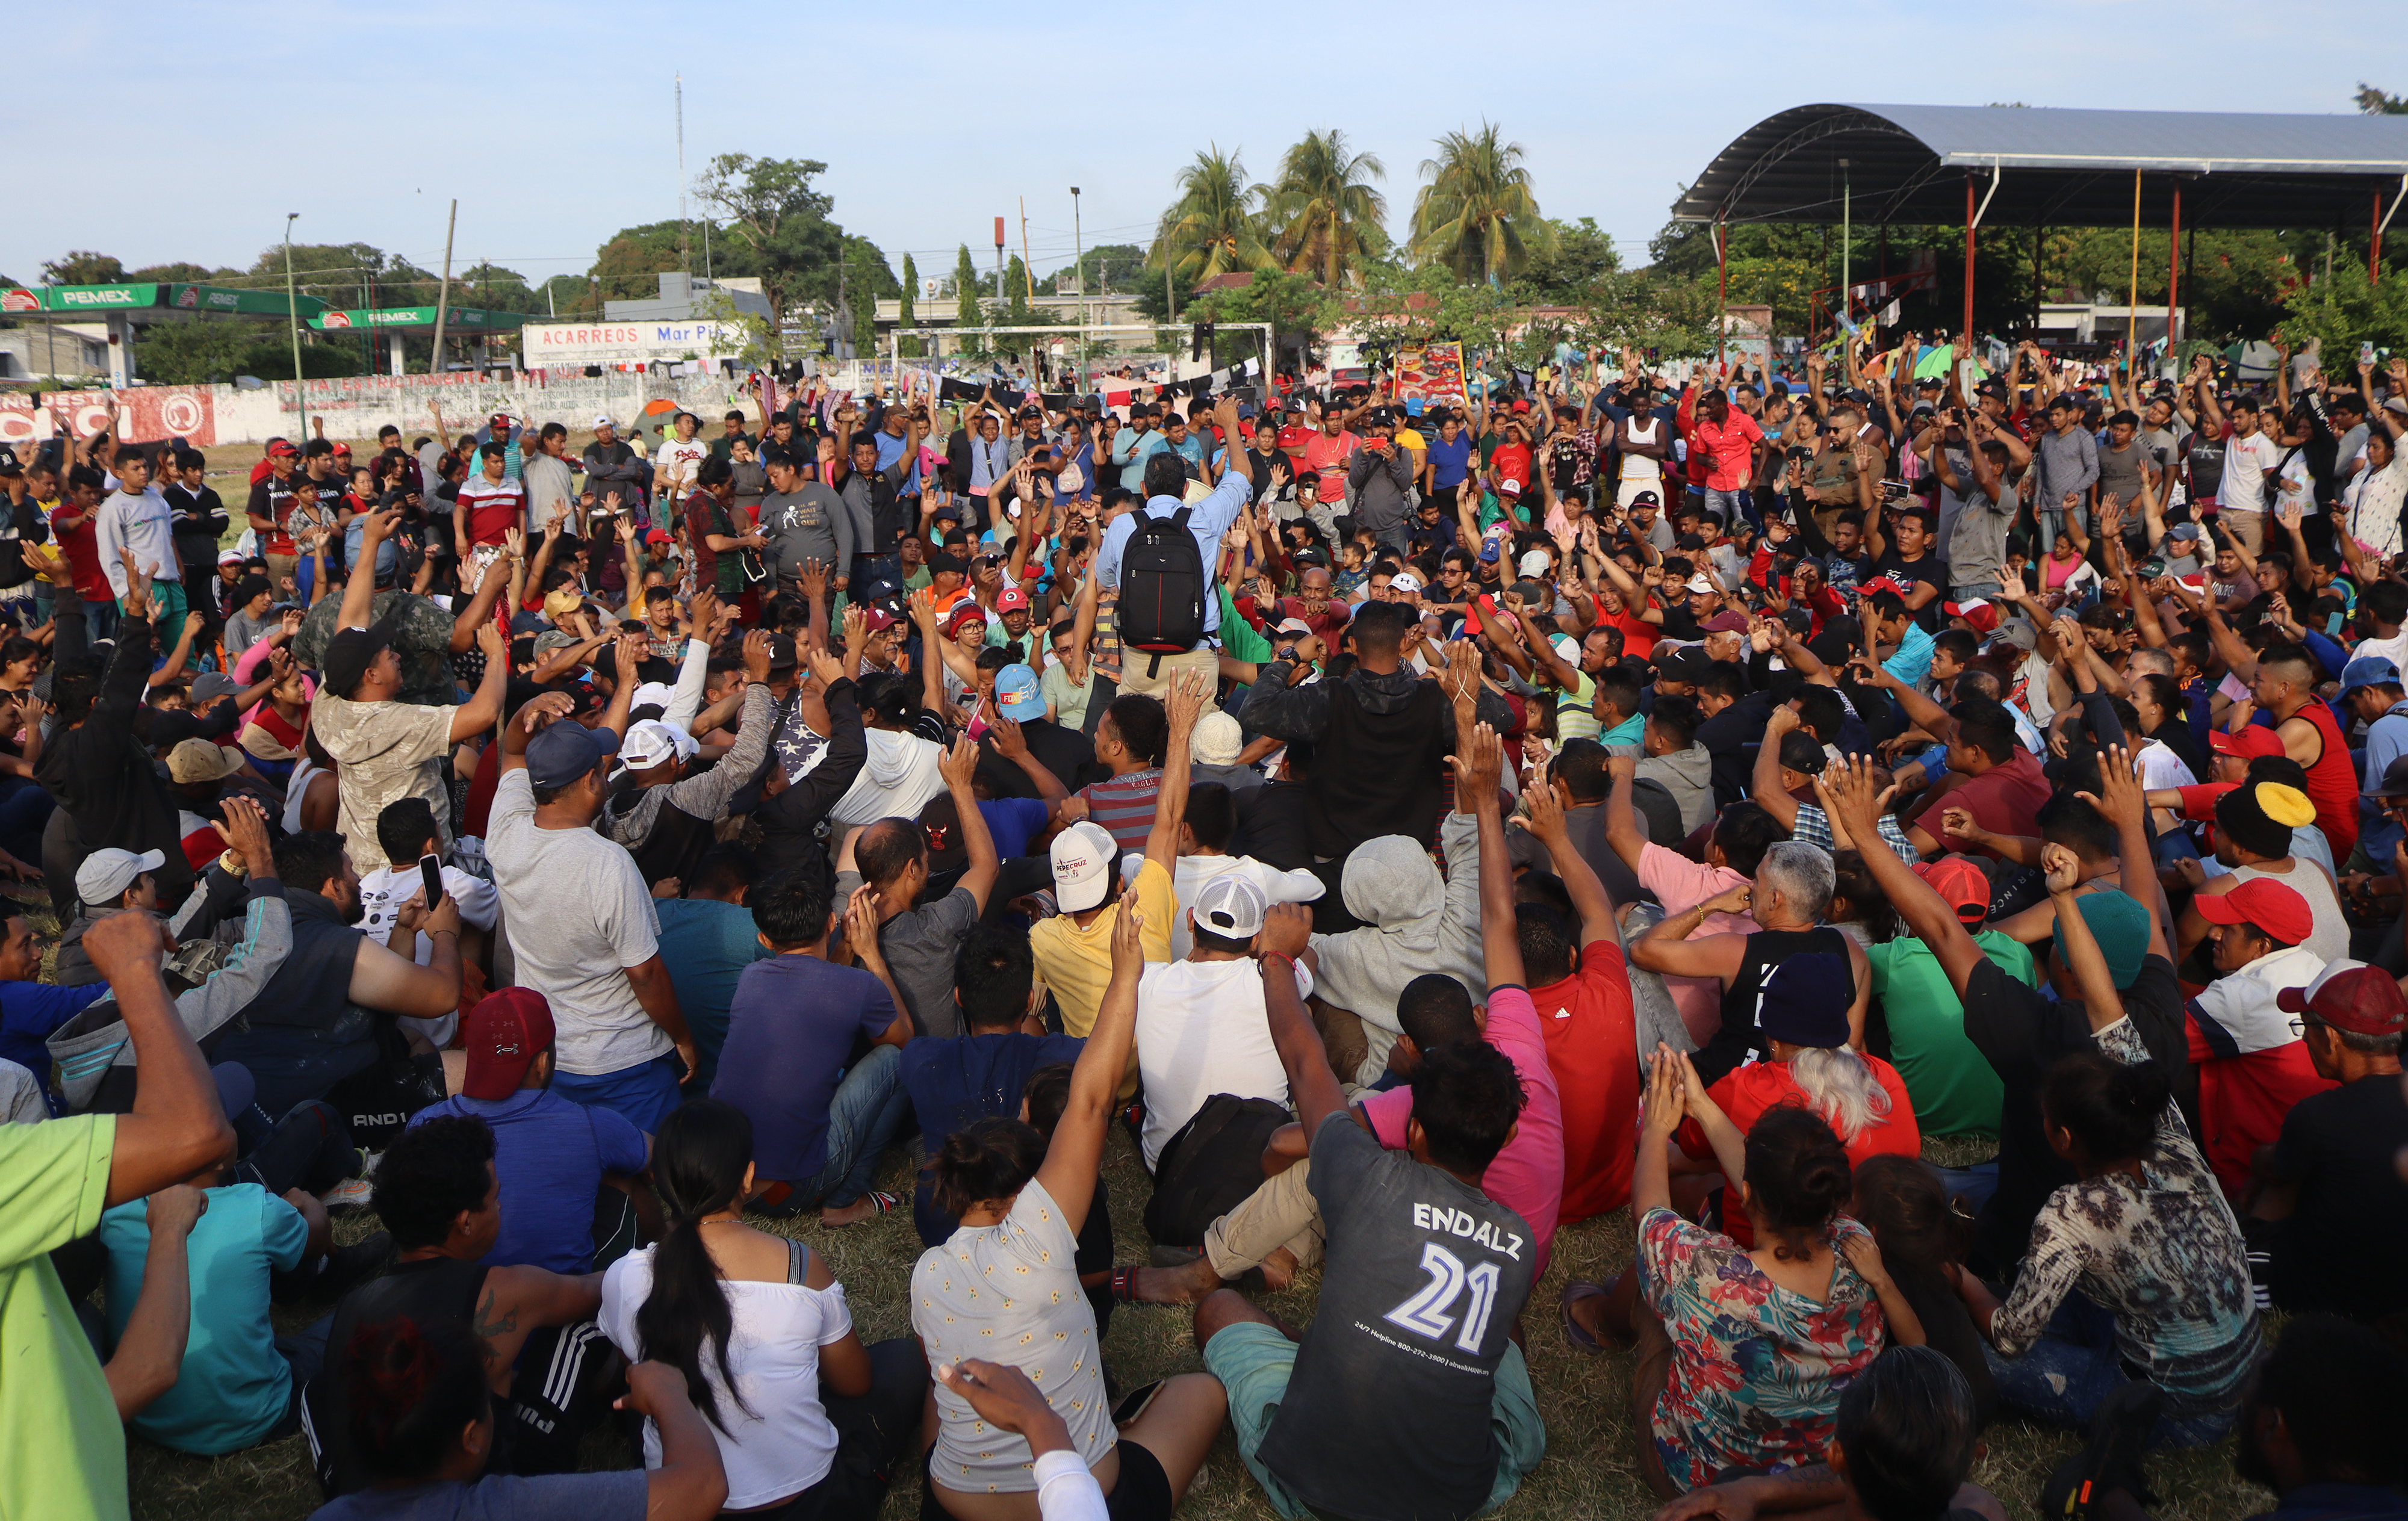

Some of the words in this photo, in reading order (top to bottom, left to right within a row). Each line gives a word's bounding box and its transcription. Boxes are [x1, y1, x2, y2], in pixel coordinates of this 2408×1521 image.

[63, 290, 134, 305] PEMEX
[208, 293, 240, 306] PEMEX
[368, 311, 418, 323] PEMEX
[543, 327, 638, 345] ACARREOS
[657, 326, 690, 341] Mar
[1487, 542, 1497, 552] T
[1120, 772, 1160, 783] AMERICAN
[1131, 778, 1155, 788] EAGLE
[1989, 868, 2036, 914] PRINCE
[1414, 1203, 1524, 1262] ENDALZ
[1383, 1241, 1501, 1355] 21
[1354, 1321, 1370, 1333] 24/7
[1370, 1329, 1397, 1347] Helpline
[1397, 1341, 1446, 1365] 800-272-3900
